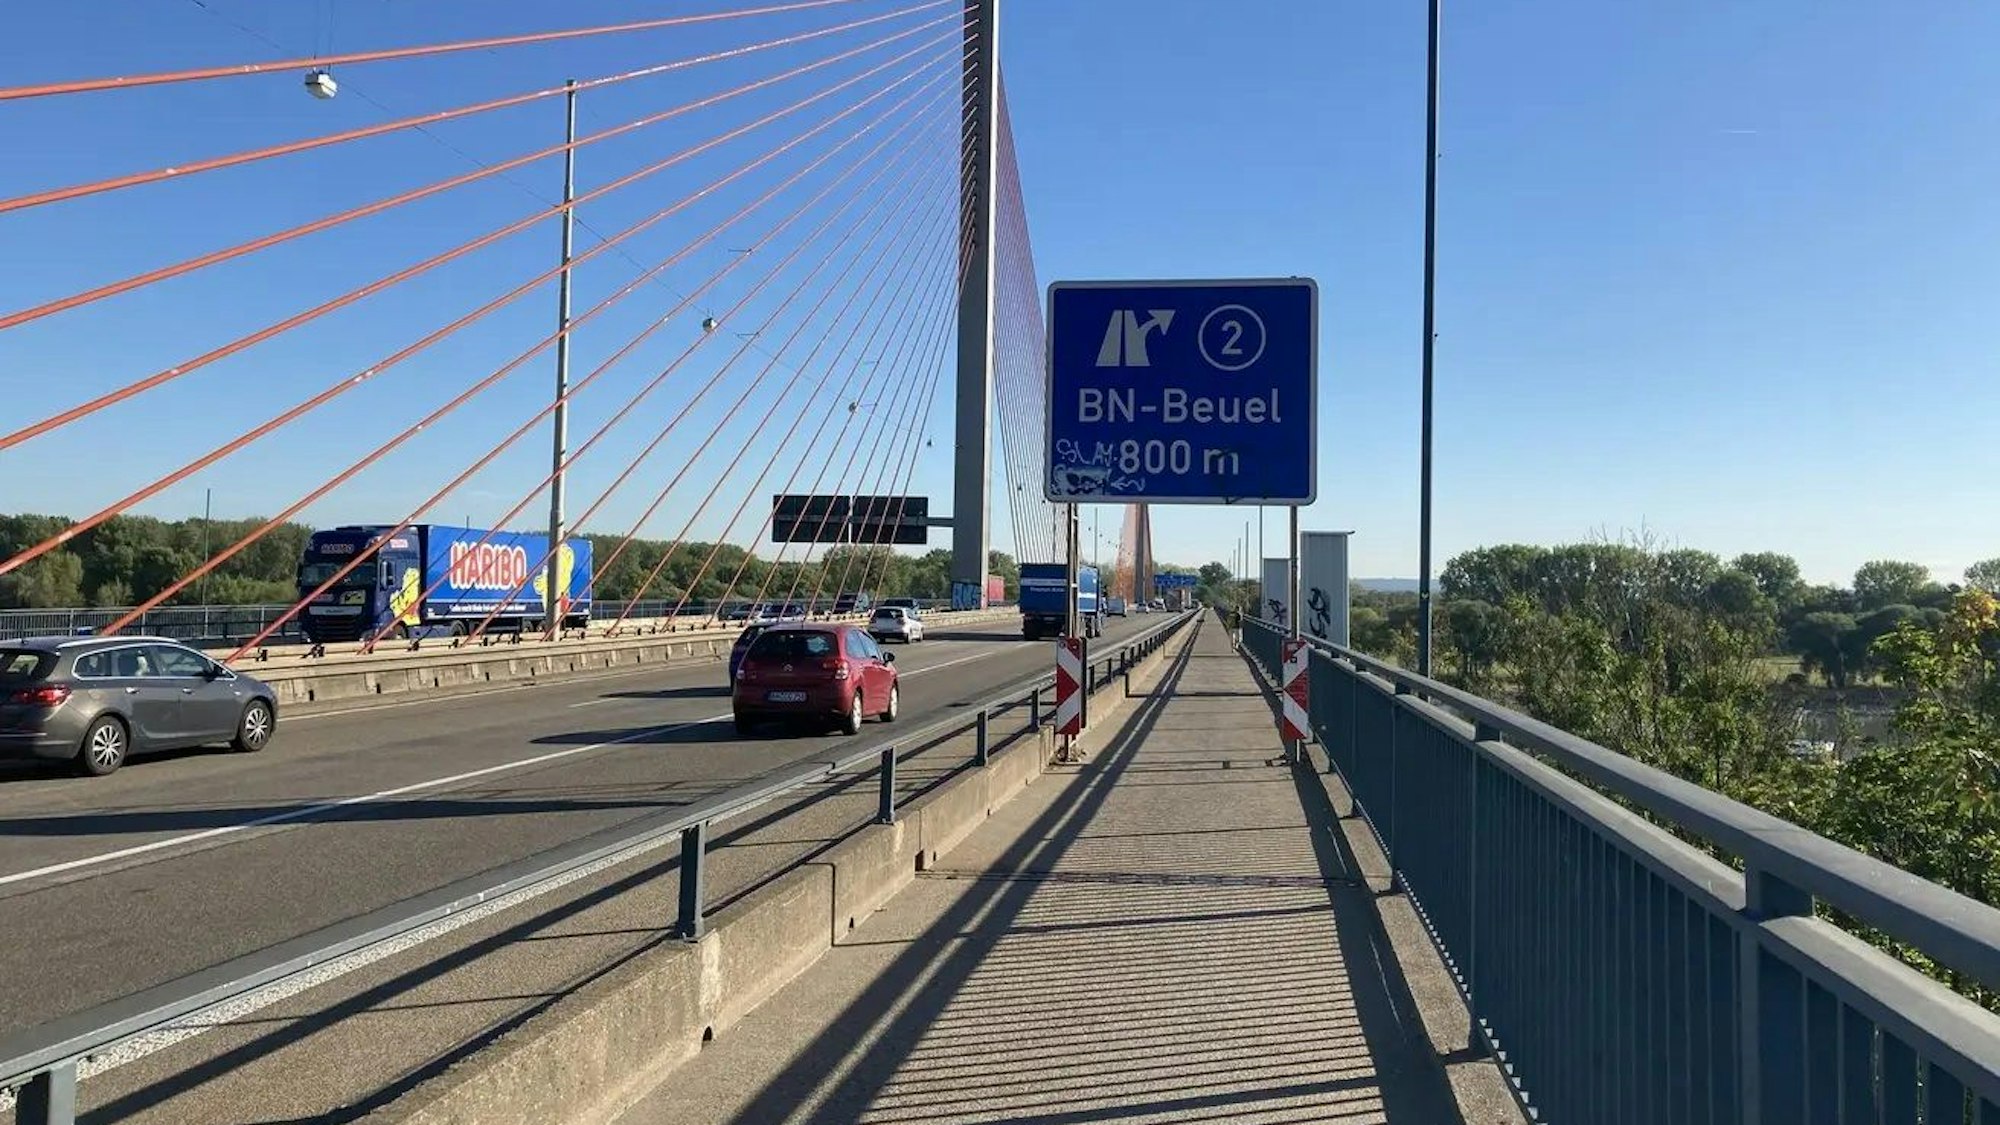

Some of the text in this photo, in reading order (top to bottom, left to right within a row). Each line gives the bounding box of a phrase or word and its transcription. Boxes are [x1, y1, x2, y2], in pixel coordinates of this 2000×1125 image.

[1220, 319, 1244, 356] 2
[1078, 387, 1282, 424] BN-Beuel
[1118, 439, 1240, 476] 800 m
[449, 540, 528, 591] HARIBO
